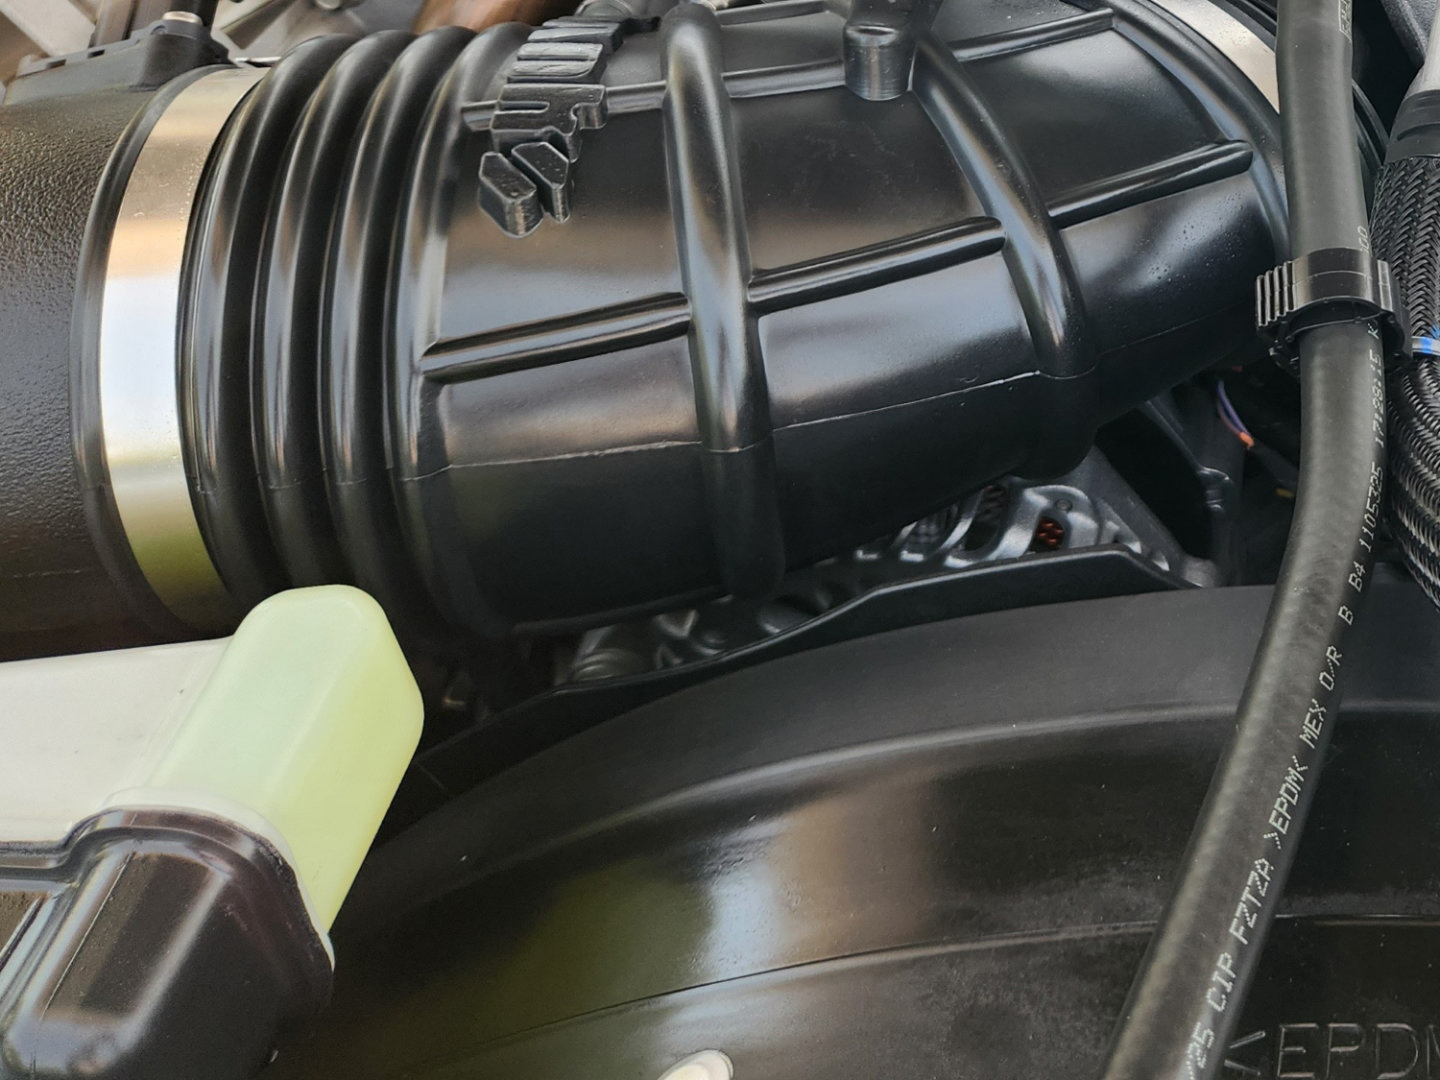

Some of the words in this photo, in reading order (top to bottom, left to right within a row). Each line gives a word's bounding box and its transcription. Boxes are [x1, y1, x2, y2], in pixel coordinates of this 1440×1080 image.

[1204, 952, 1236, 1013] CIP
[1300, 699, 1329, 748] MEX
[1340, 604, 1354, 625] B
[1348, 561, 1367, 594] B4
